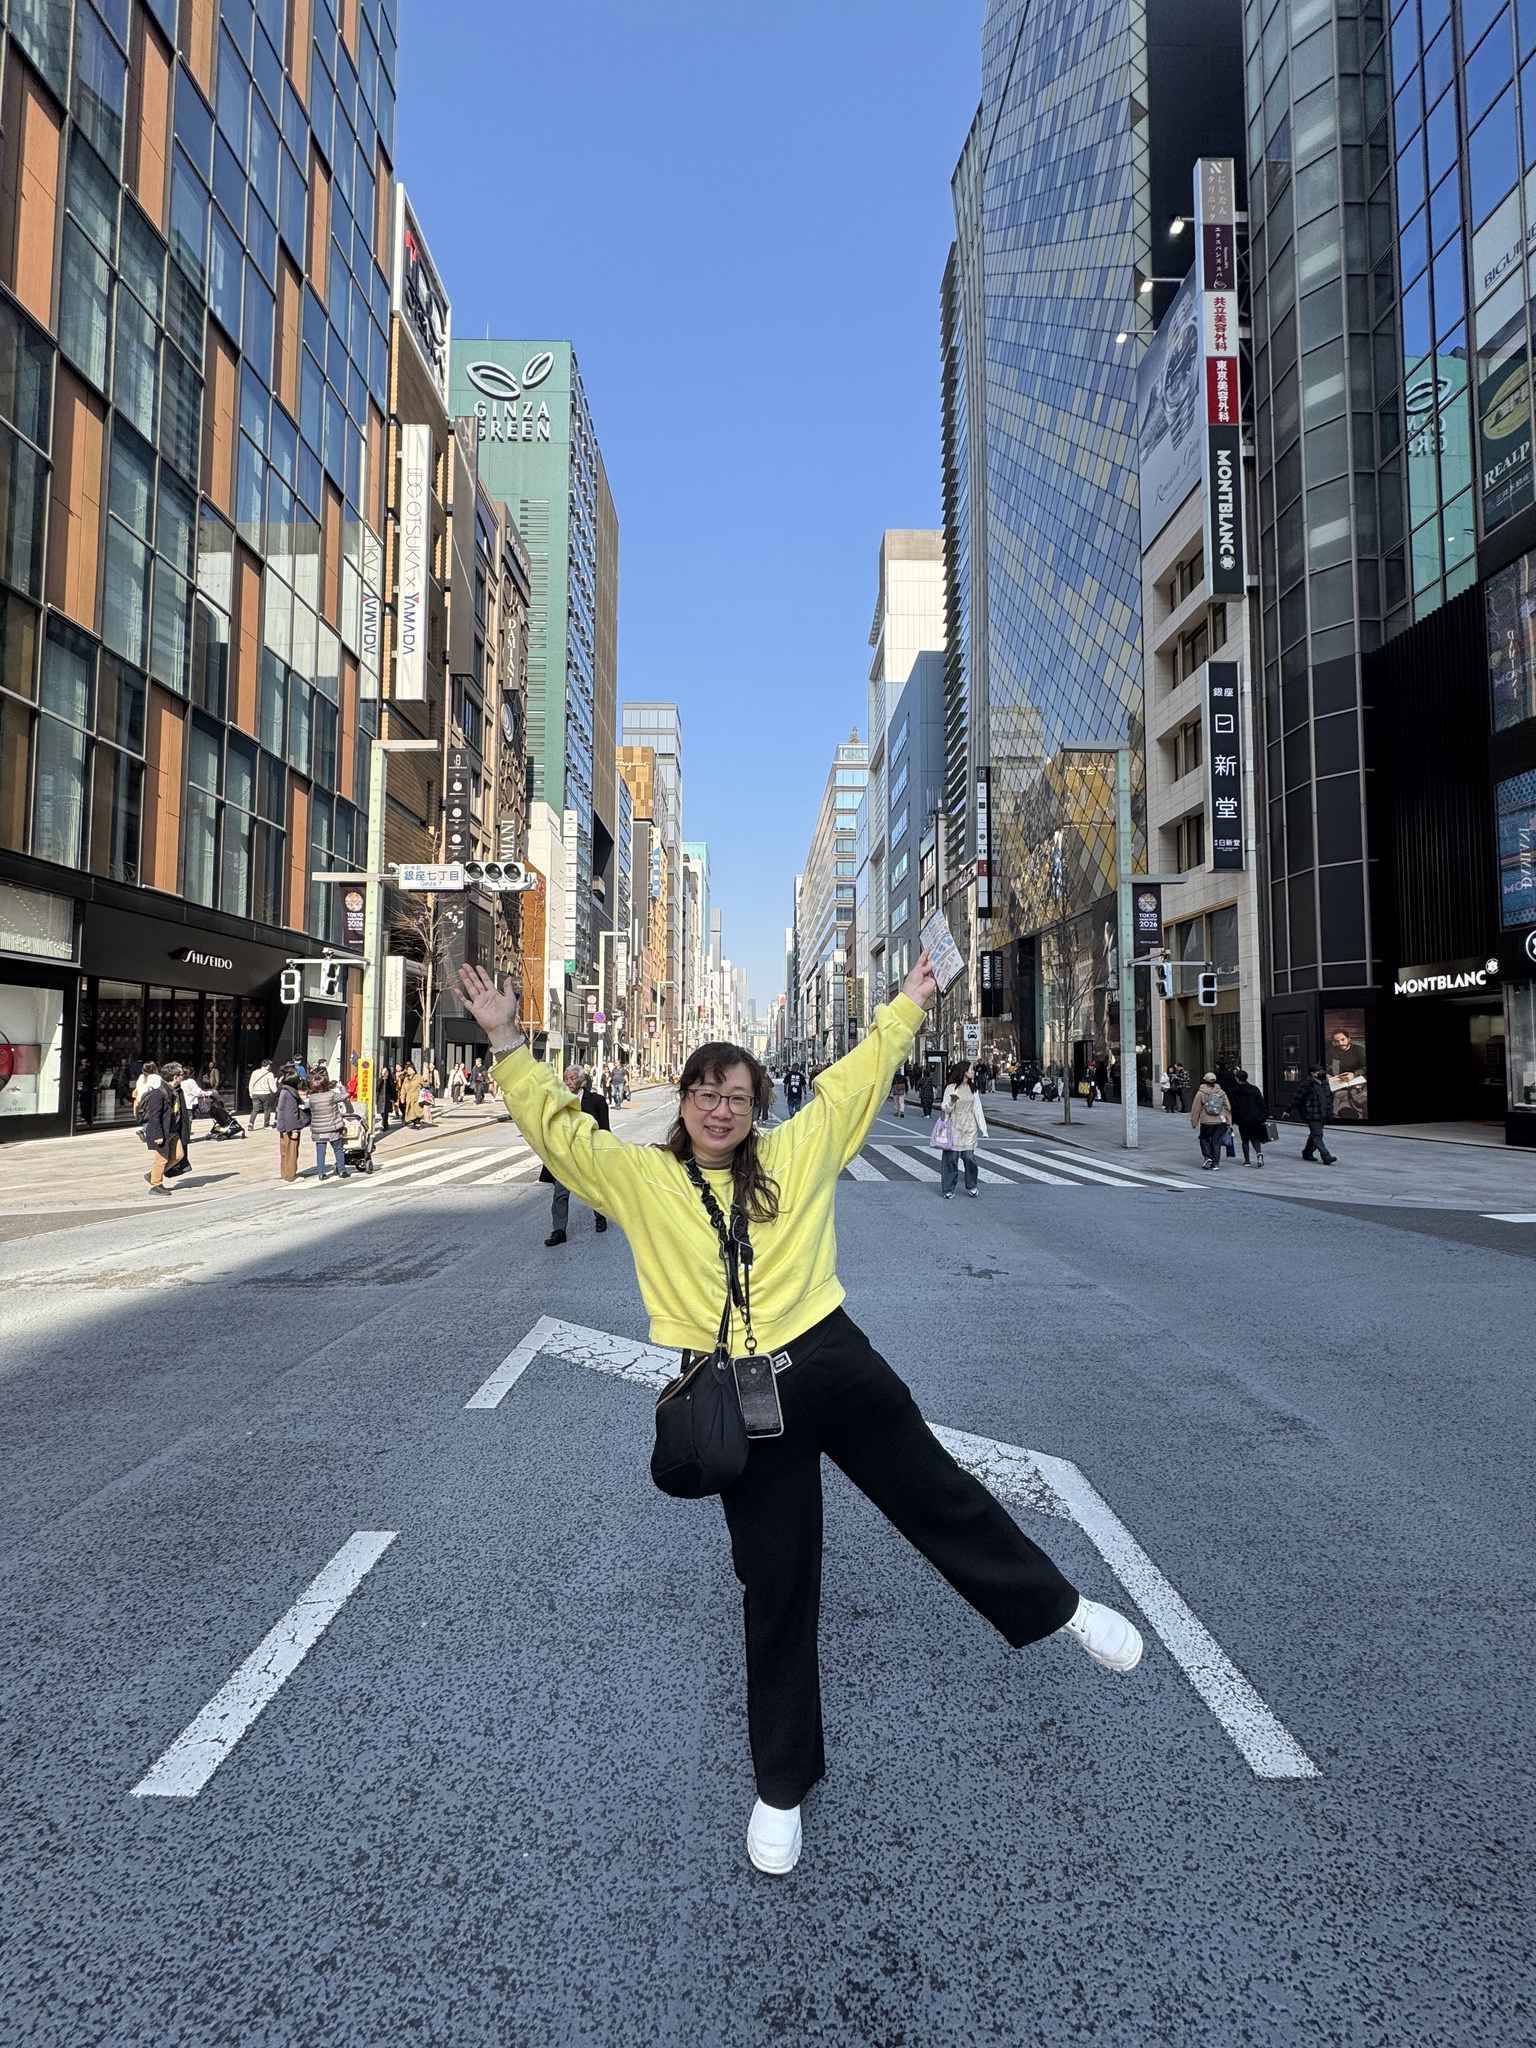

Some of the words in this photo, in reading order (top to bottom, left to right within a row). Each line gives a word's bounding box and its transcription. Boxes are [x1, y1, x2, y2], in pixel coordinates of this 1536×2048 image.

[1214, 296, 1228, 351] 共立美容外科
[473, 400, 550, 417] GINZA
[1216, 360, 1230, 422] 東京美容外科
[477, 421, 551, 441] GREEN
[1216, 450, 1235, 555] MONTBLANC
[404, 501, 422, 572] OTSUKA
[402, 592, 420, 656] YAMADA
[507, 619, 517, 688] DAMIANI
[1213, 687, 1234, 697] 銀座
[1214, 714, 1238, 818] 日新堂
[500, 819, 515, 862] MIANI
[404, 870, 459, 881] 銀座七丁目
[182, 949, 233, 970] SHISEIDO
[983, 955, 991, 981] YAMAHA
[1394, 969, 1487, 995] MONTBLANC
